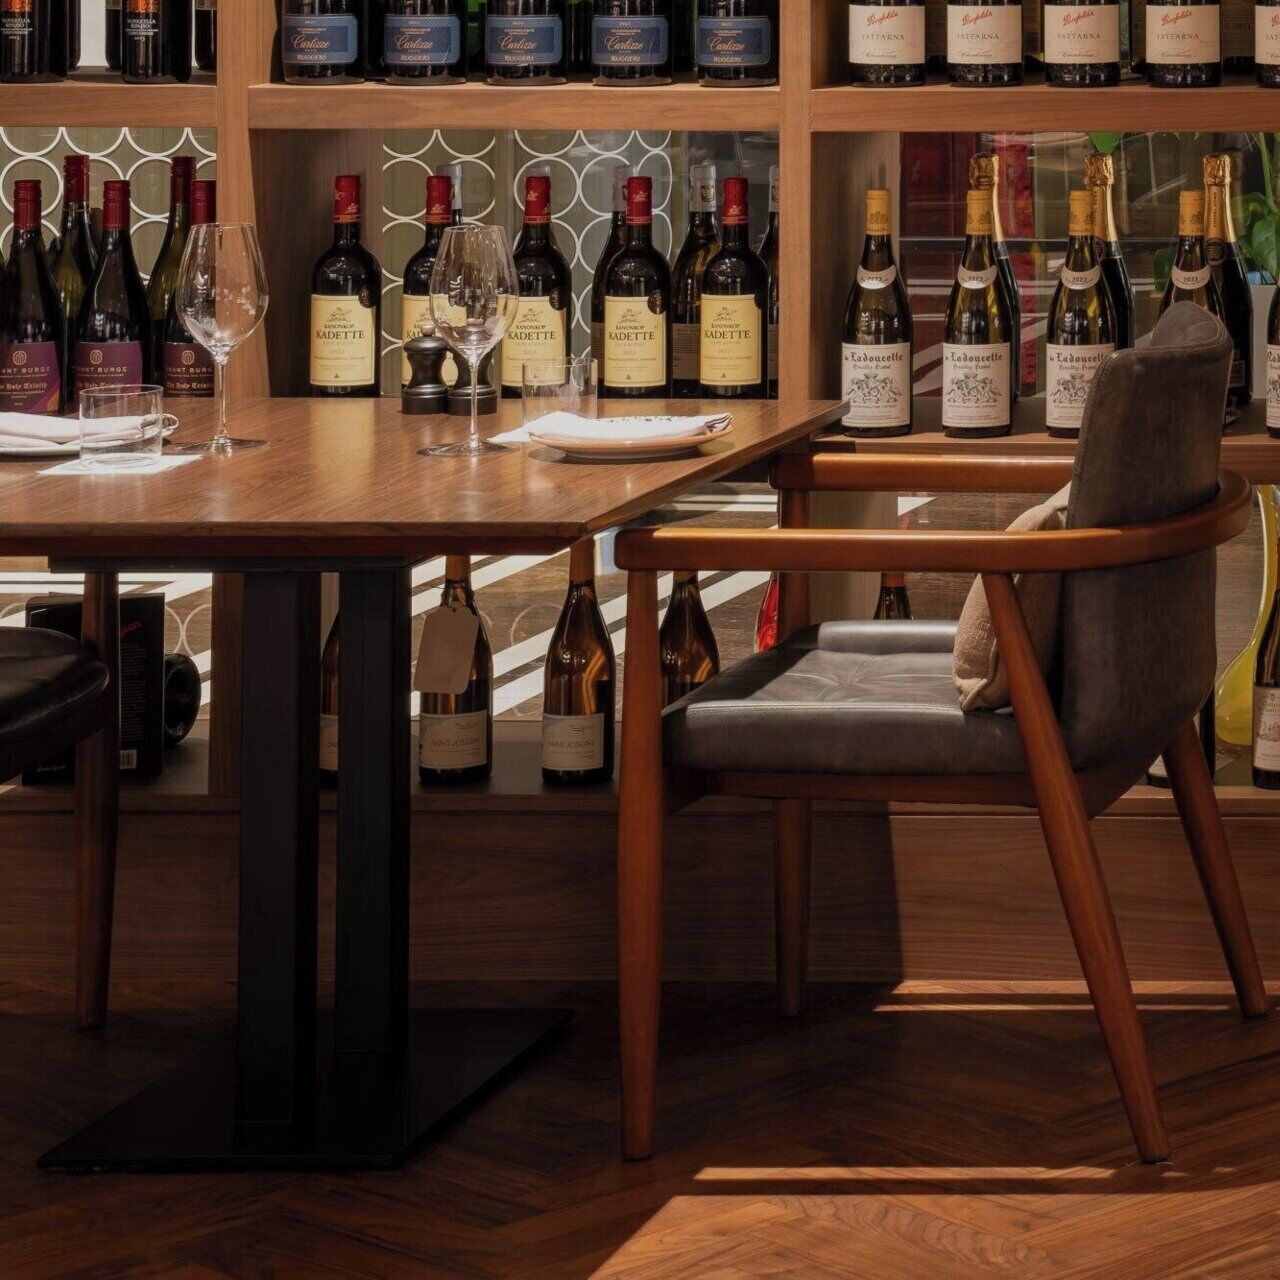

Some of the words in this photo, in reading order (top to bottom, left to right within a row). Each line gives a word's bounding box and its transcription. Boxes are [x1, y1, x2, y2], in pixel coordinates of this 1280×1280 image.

[316, 330, 364, 340] KADETTE
[508, 331, 556, 340] KADETTE
[609, 331, 655, 340] KADETTE
[704, 330, 751, 339] KADETTE
